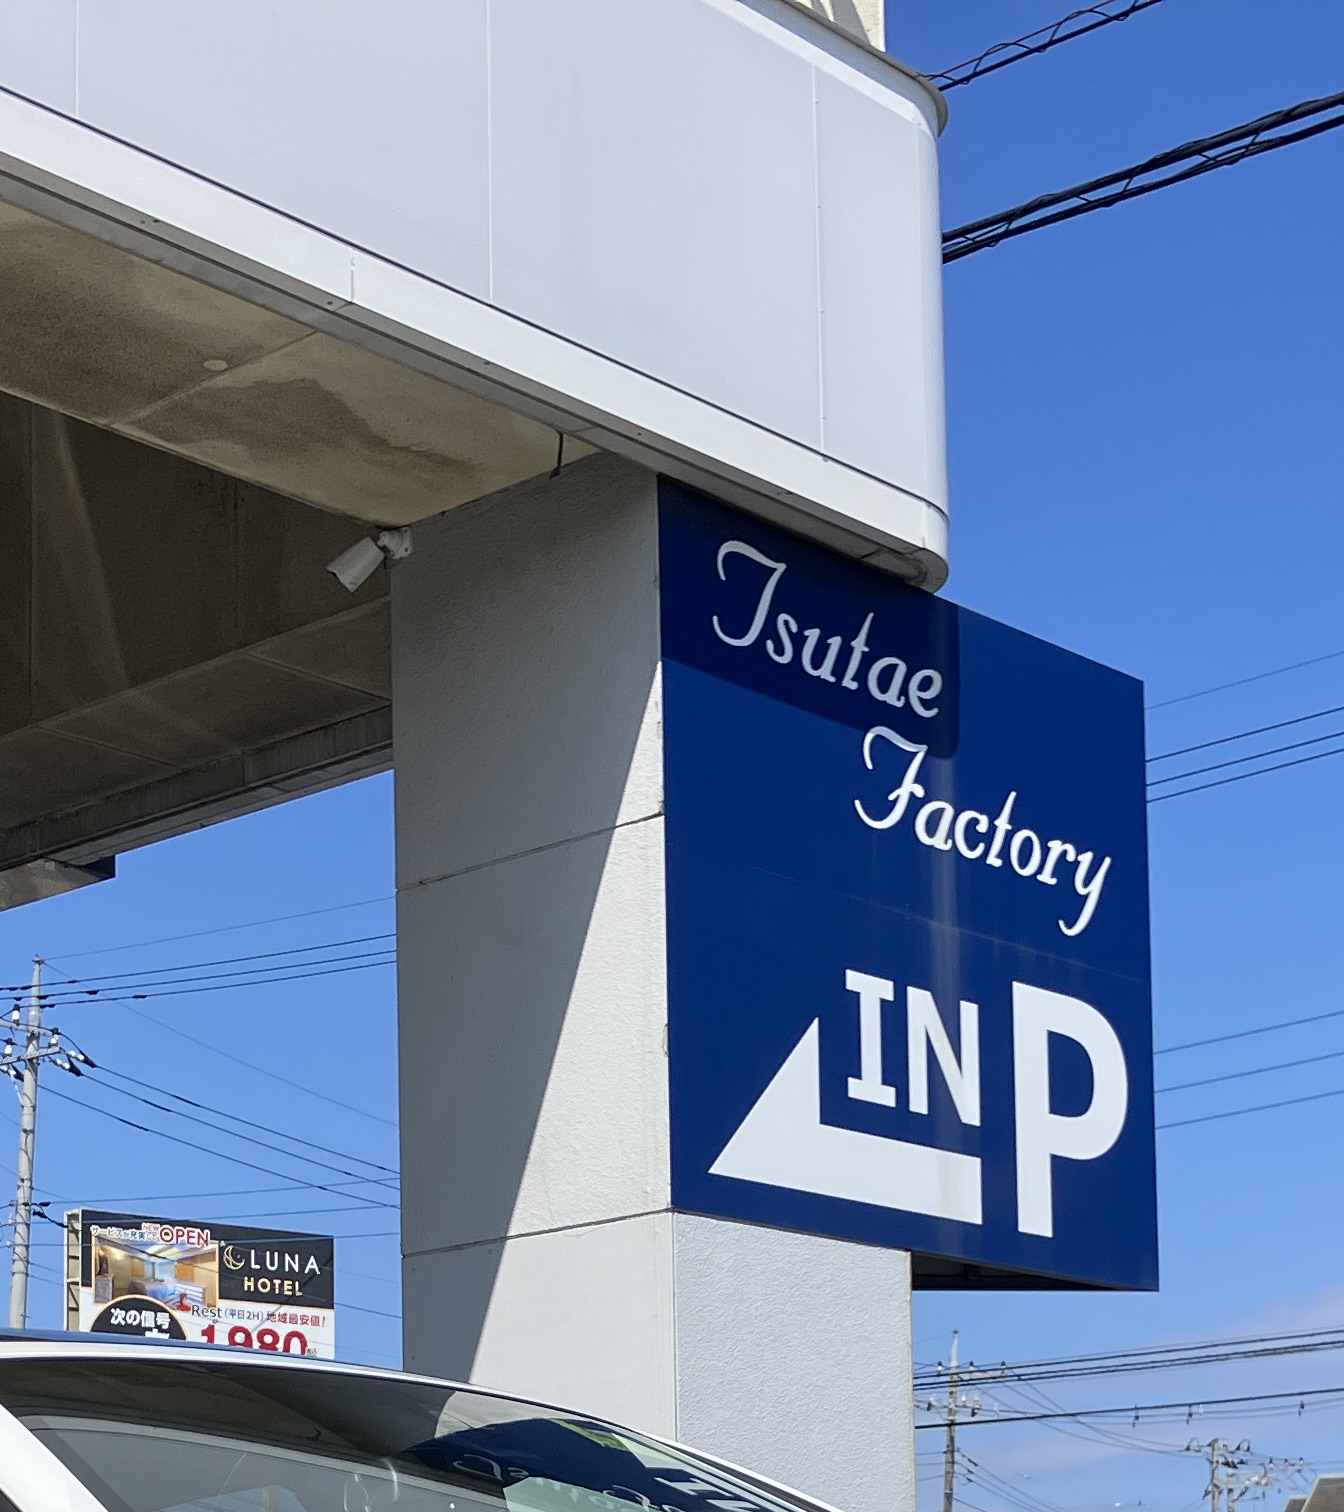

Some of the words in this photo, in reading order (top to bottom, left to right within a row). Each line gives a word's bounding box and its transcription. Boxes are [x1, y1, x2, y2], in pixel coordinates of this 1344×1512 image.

[712, 540, 944, 718] Tsutae
[854, 724, 1112, 937] Factory
[844, 968, 981, 1127] IN
[1011, 980, 1130, 1239] P
[159, 1227, 210, 1247] OPEN
[250, 1249, 321, 1275] LUNA
[243, 1276, 304, 1297] HOTEL
[110, 1307, 171, 1330] 次の信号
[192, 1304, 222, 1319] Rest
